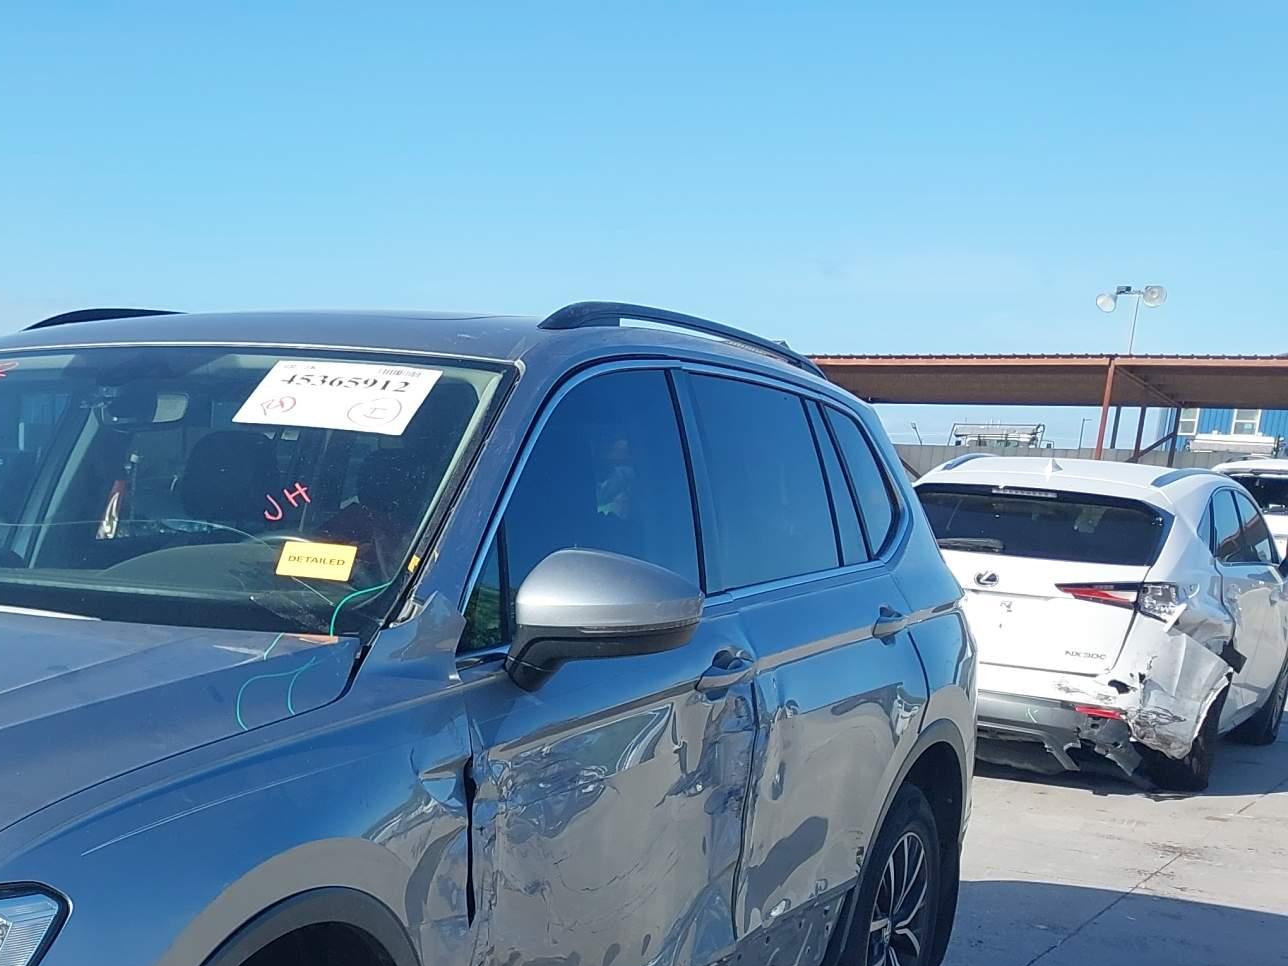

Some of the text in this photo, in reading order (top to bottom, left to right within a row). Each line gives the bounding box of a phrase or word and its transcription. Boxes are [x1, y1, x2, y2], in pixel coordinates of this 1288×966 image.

[281, 374, 411, 393] 45365912
[263, 482, 311, 521] JH
[288, 555, 346, 567] DETAILED
